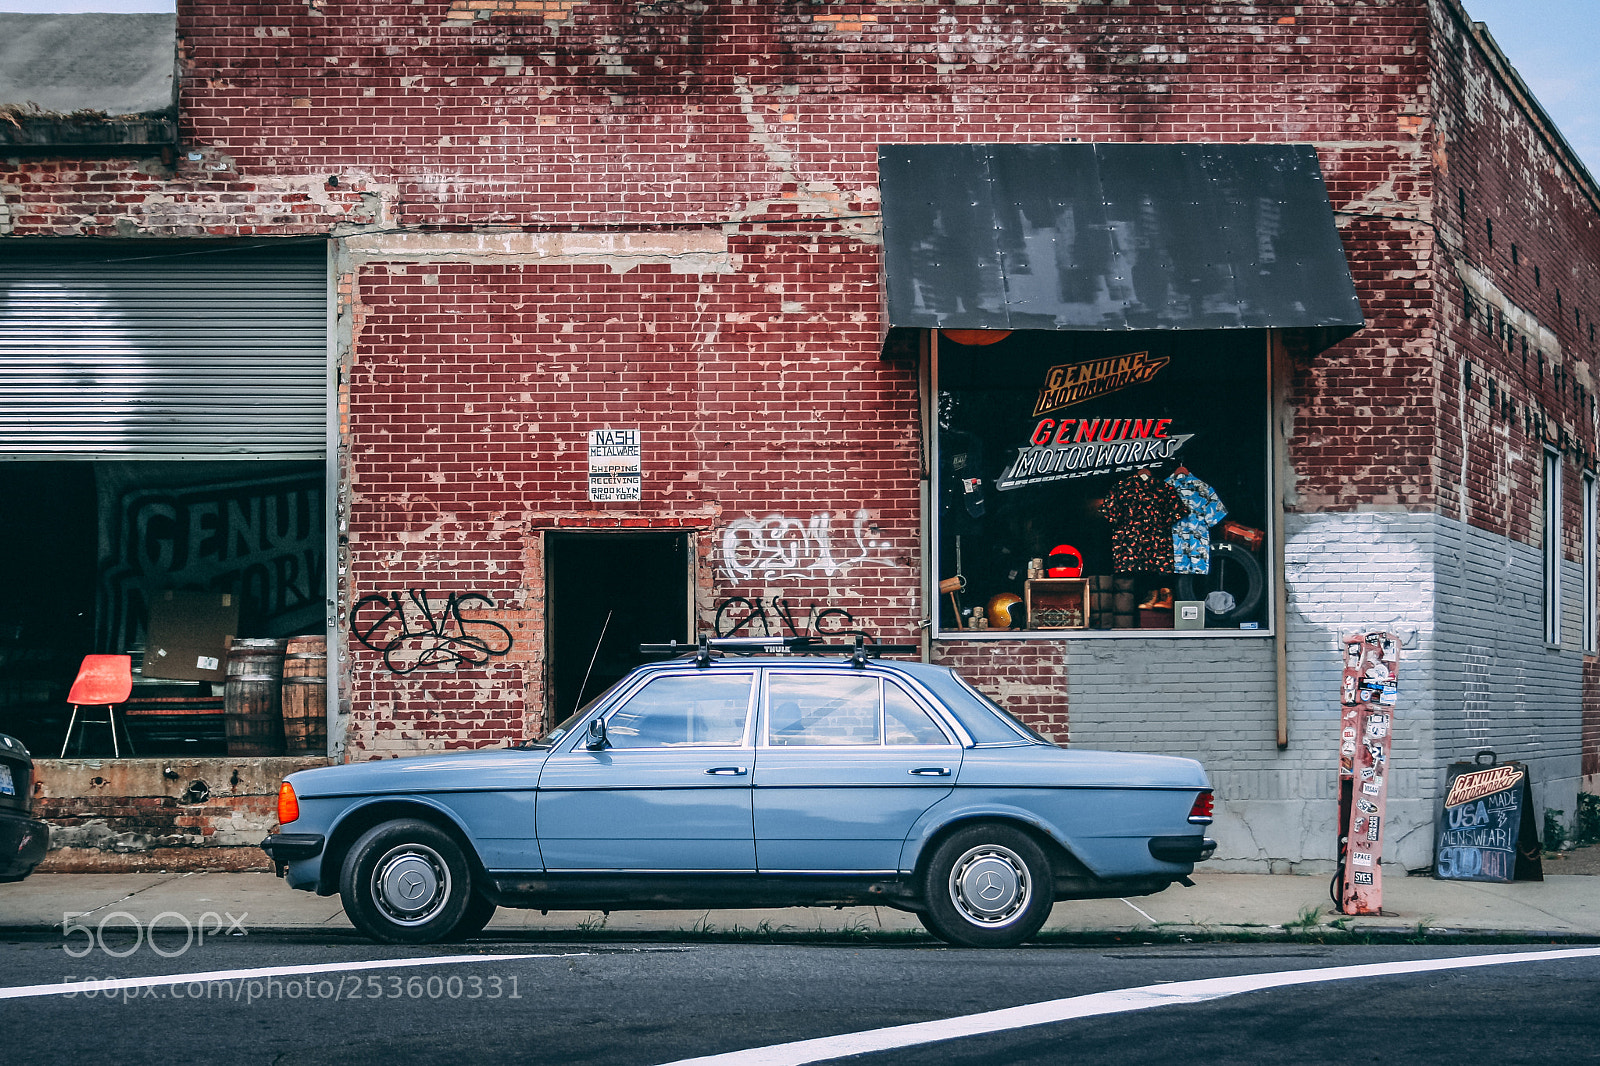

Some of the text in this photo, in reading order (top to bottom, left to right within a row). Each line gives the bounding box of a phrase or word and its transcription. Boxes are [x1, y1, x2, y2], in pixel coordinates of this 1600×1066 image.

[1048, 354, 1145, 389] GENUINE
[596, 431, 635, 445] NASH
[1031, 418, 1173, 445] GENUINE
[590, 446, 639, 456] METALWARE
[1007, 439, 1177, 479] MOTORWORKS
[1000, 468, 1110, 487] BROOKLYN
[763, 645, 791, 653] THULE
[1456, 767, 1512, 790] GENUINE
[1446, 790, 1518, 829] USA MADE
[1353, 853, 1371, 861] SPACE
